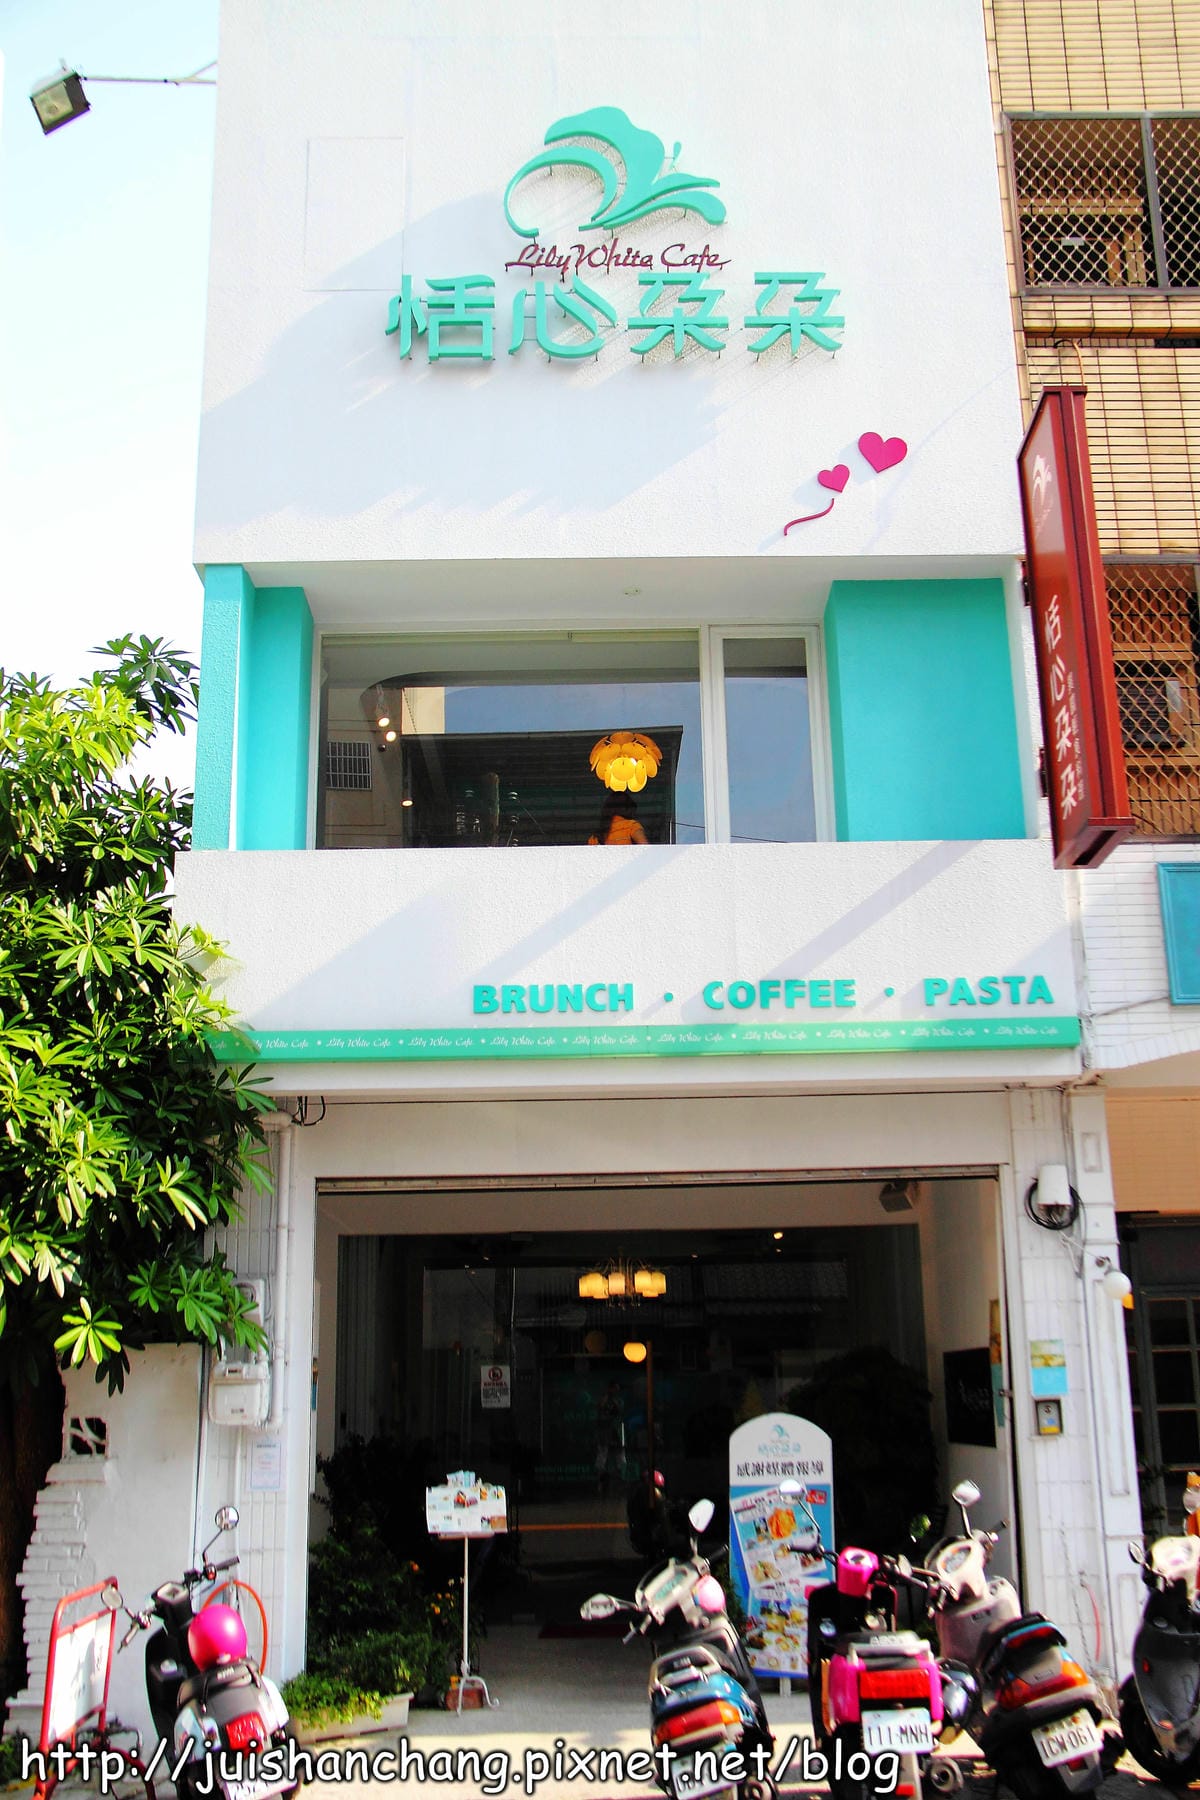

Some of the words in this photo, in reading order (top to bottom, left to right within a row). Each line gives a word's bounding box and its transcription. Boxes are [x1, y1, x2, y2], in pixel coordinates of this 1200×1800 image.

[505, 243, 570, 273] Lily
[570, 238, 653, 267] White
[661, 244, 732, 269] Cafe
[386, 272, 845, 361] 恬心朵朵
[1044, 594, 1078, 821] 恬心朵朵
[473, 983, 634, 1014] BRUNCH
[703, 979, 856, 1009] COFFEE
[923, 975, 1055, 1006] PASTA
